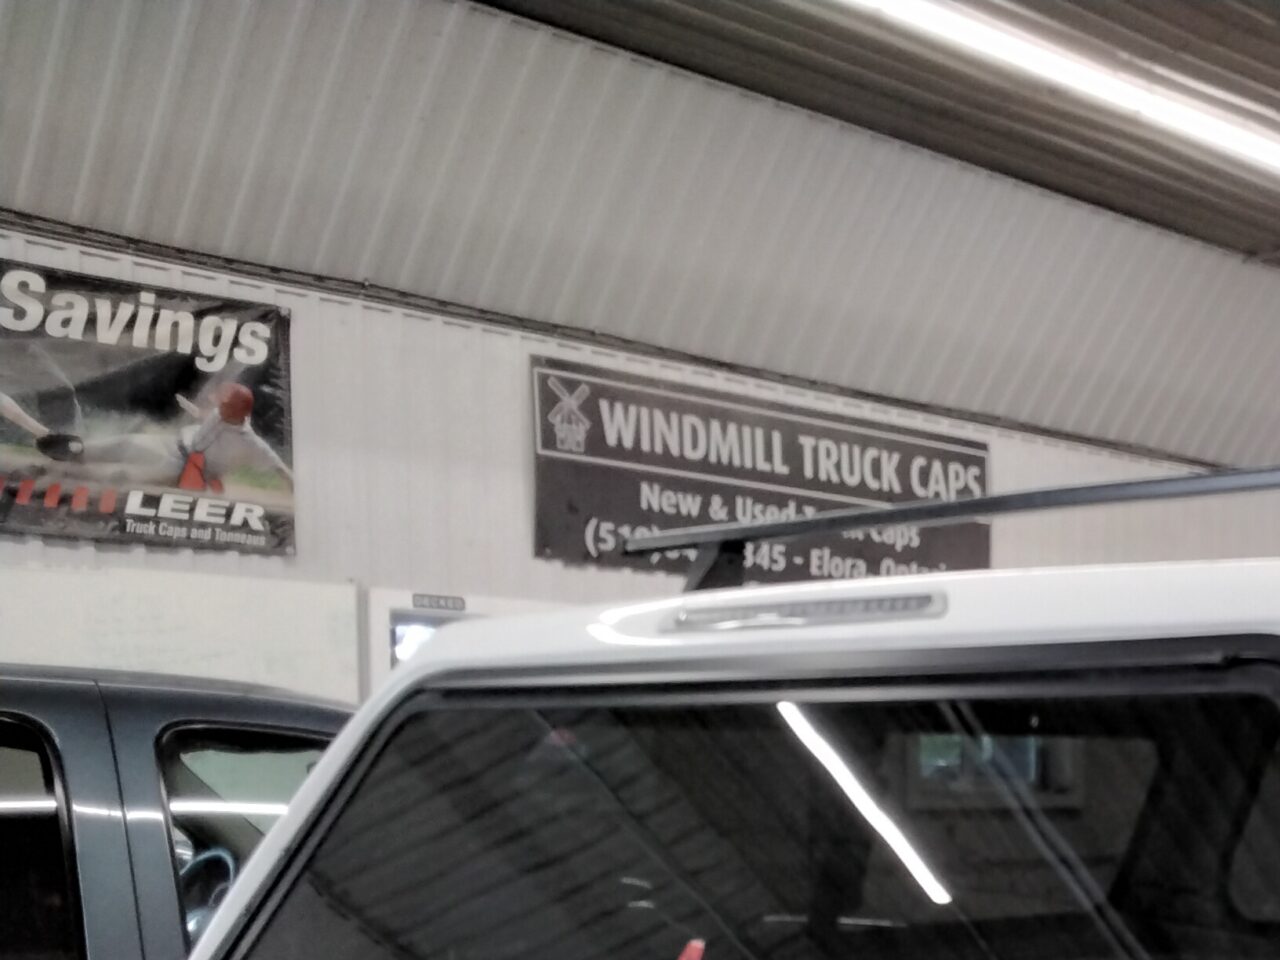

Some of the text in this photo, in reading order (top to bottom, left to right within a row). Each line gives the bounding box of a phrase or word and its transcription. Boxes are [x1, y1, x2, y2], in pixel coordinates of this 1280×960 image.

[0, 269, 271, 372] Savings
[599, 398, 981, 502] WINDMILL TRUCK CAPS
[124, 490, 265, 531] LEER
[639, 481, 702, 518] New
[708, 494, 729, 521] &
[734, 495, 797, 524] Used
[125, 519, 156, 535] Truck
[158, 523, 188, 540] Caps
[190, 527, 212, 541] and
